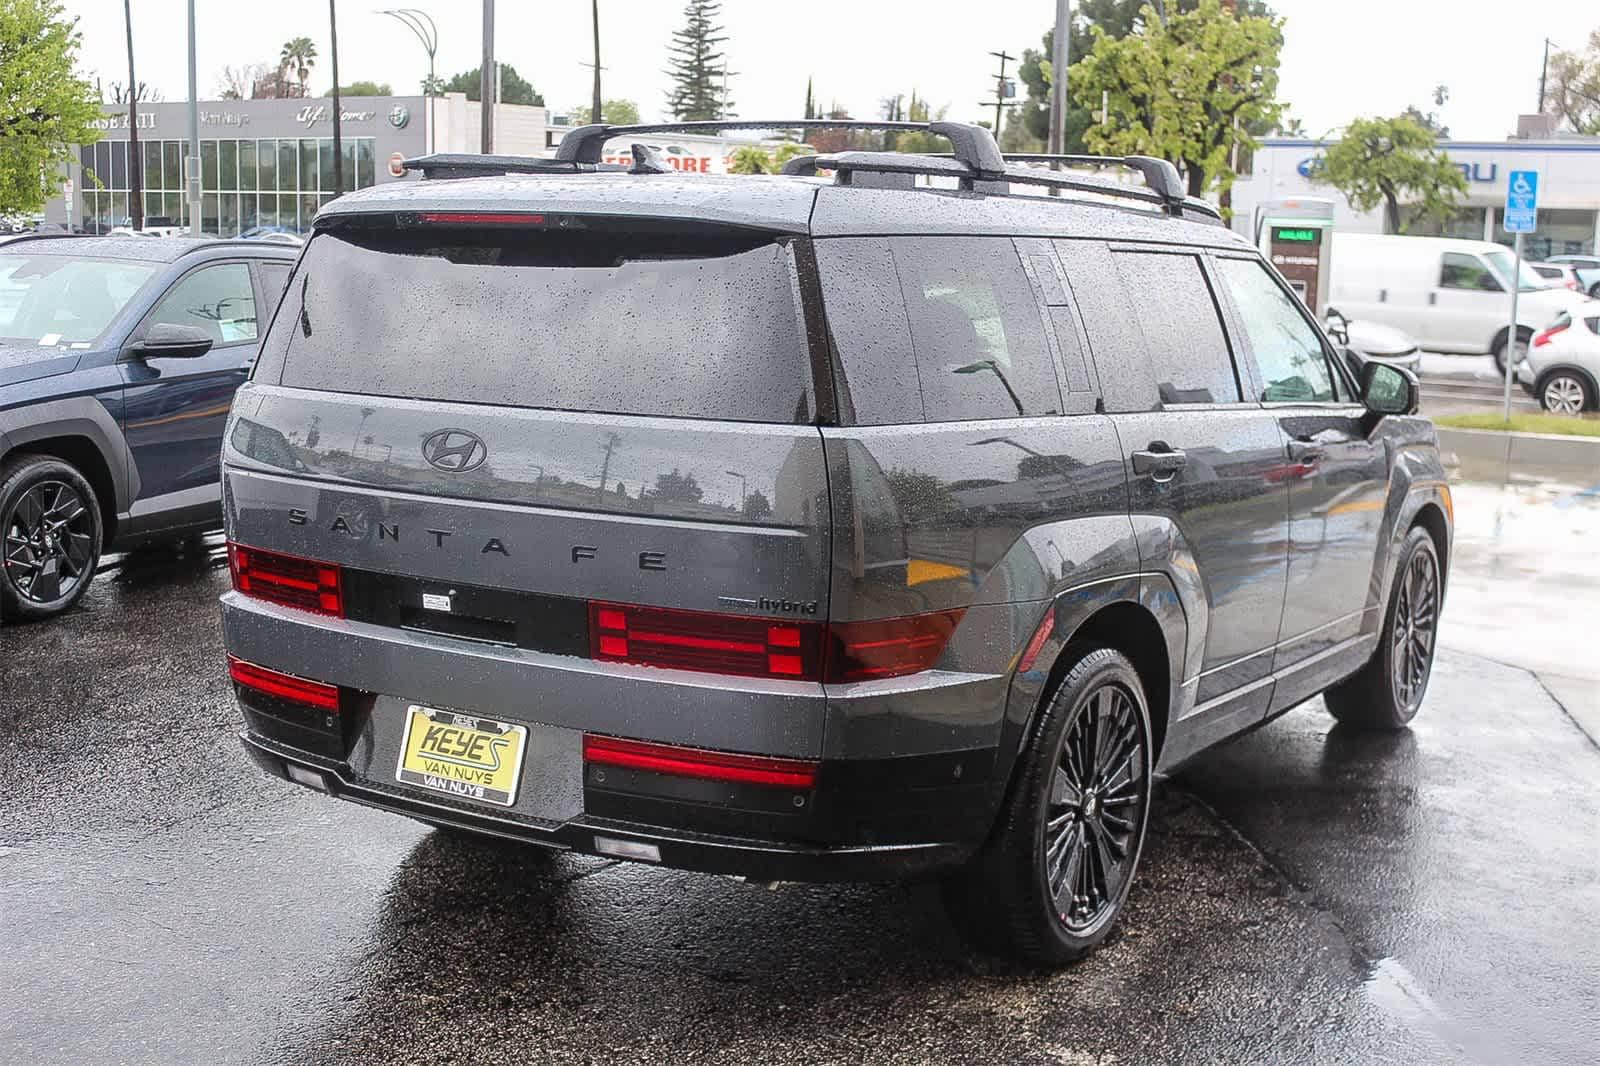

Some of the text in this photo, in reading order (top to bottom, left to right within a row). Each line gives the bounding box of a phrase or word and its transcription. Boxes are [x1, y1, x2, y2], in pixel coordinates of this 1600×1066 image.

[288, 508, 667, 571] SANTA FE
[759, 596, 817, 614] hybrid
[419, 725, 511, 770] KEYES
[424, 760, 494, 785] VAN NUYS
[423, 775, 485, 797] VAN NUYS
